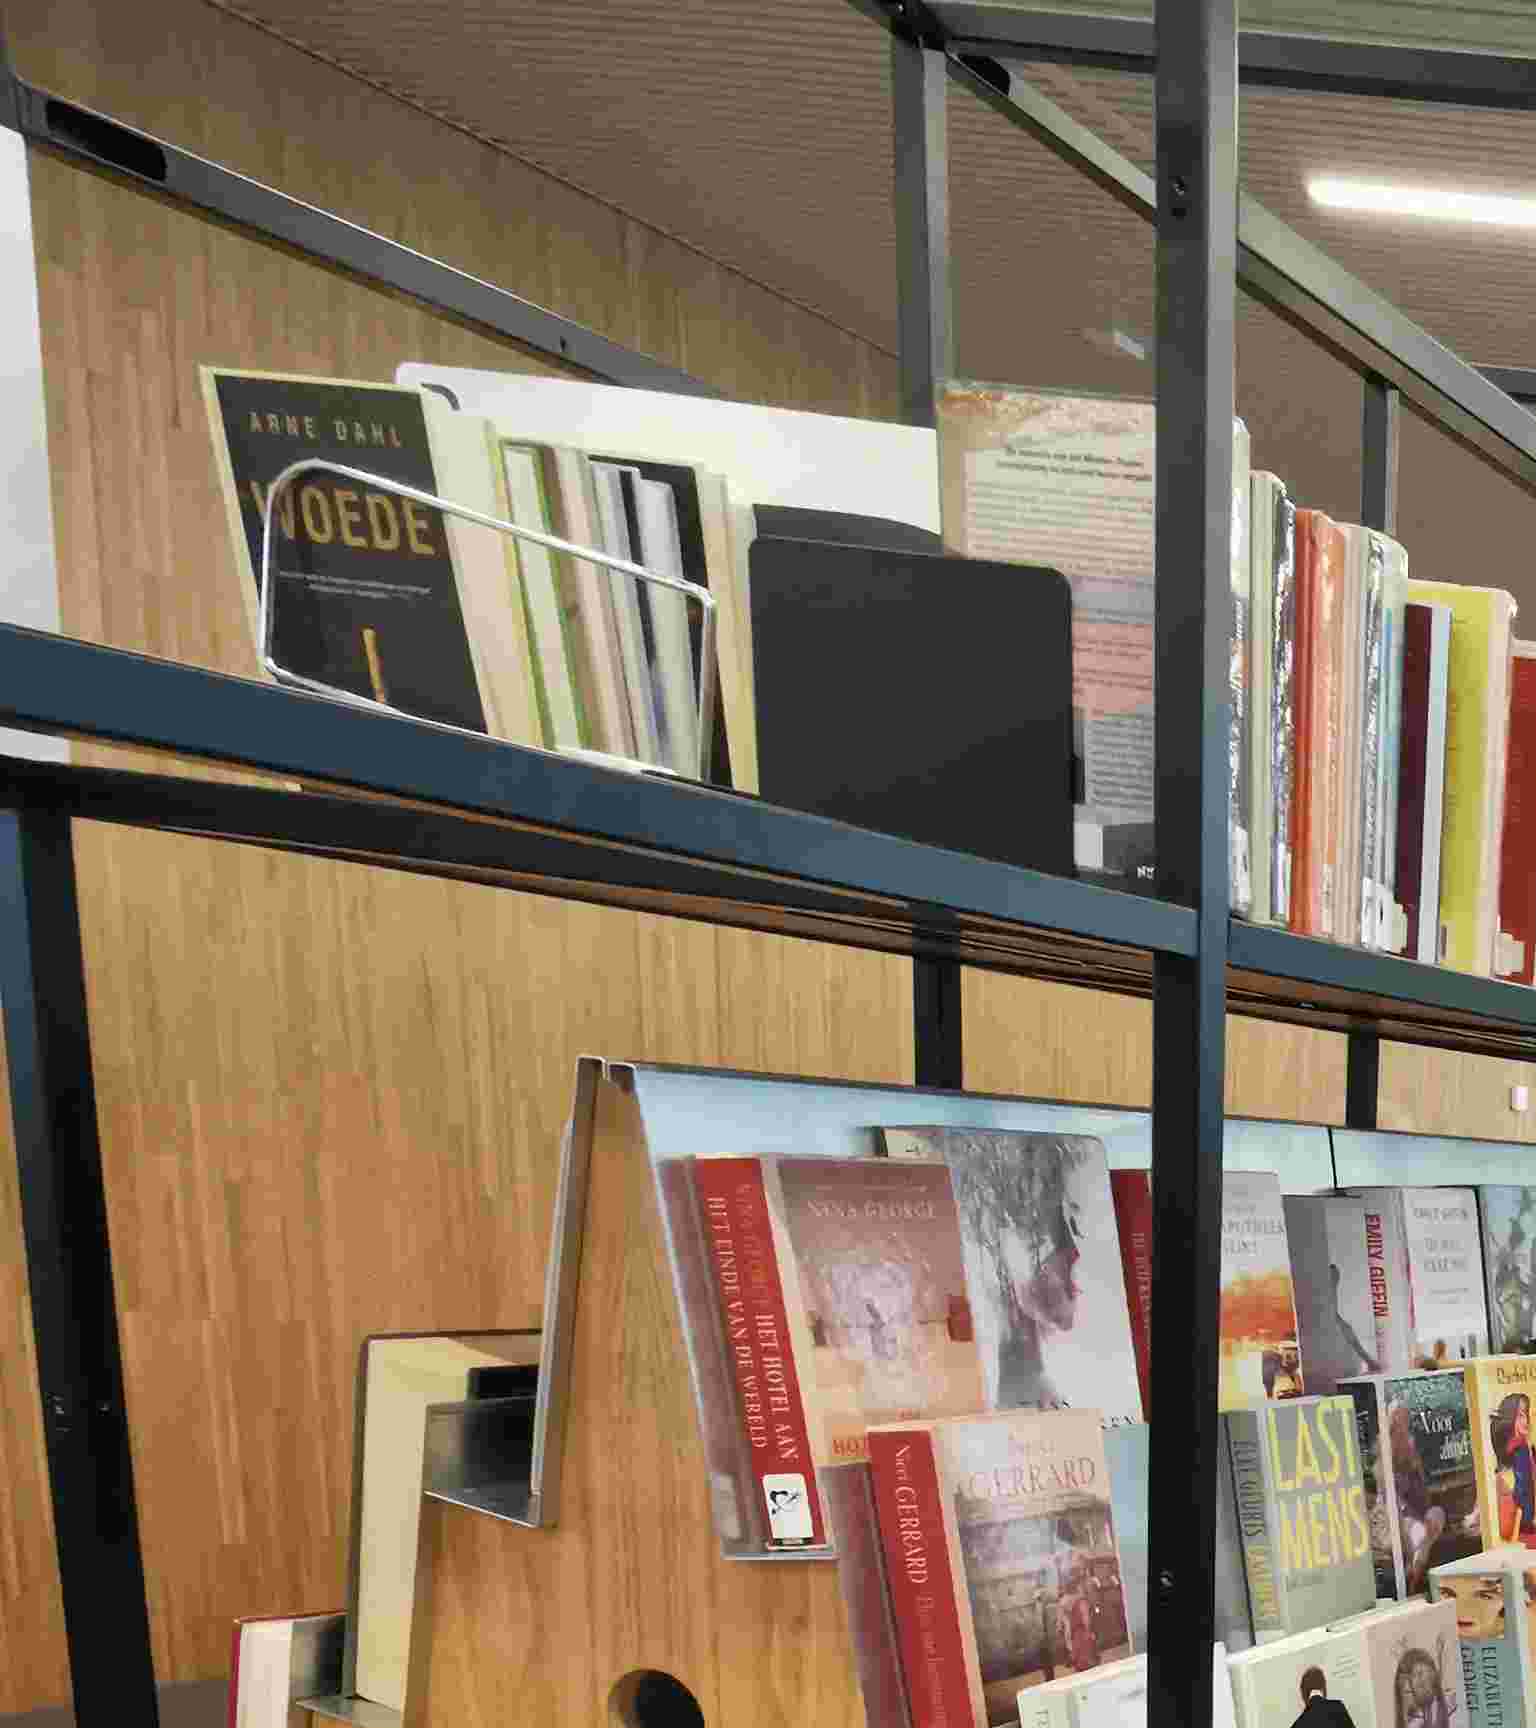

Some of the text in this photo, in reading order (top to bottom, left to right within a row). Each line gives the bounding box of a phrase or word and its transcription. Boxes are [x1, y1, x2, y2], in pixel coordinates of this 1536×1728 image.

[250, 411, 401, 447] ARNE DAHL
[250, 478, 436, 557] WOEDE
[806, 1199, 937, 1219] NINA GEORGE
[1365, 1213, 1389, 1318] EMILY GIFFIN
[706, 1196, 770, 1450] HET EINDE VAN DE WERELD
[756, 1313, 801, 1463] HET HOTEL AAN
[1418, 1412, 1455, 1434] Voor
[968, 1456, 1098, 1497] GERRARD
[1267, 1395, 1357, 1490] LAST
[894, 1484, 929, 1587] GERRARD
[1279, 1486, 1370, 1570] MENS
